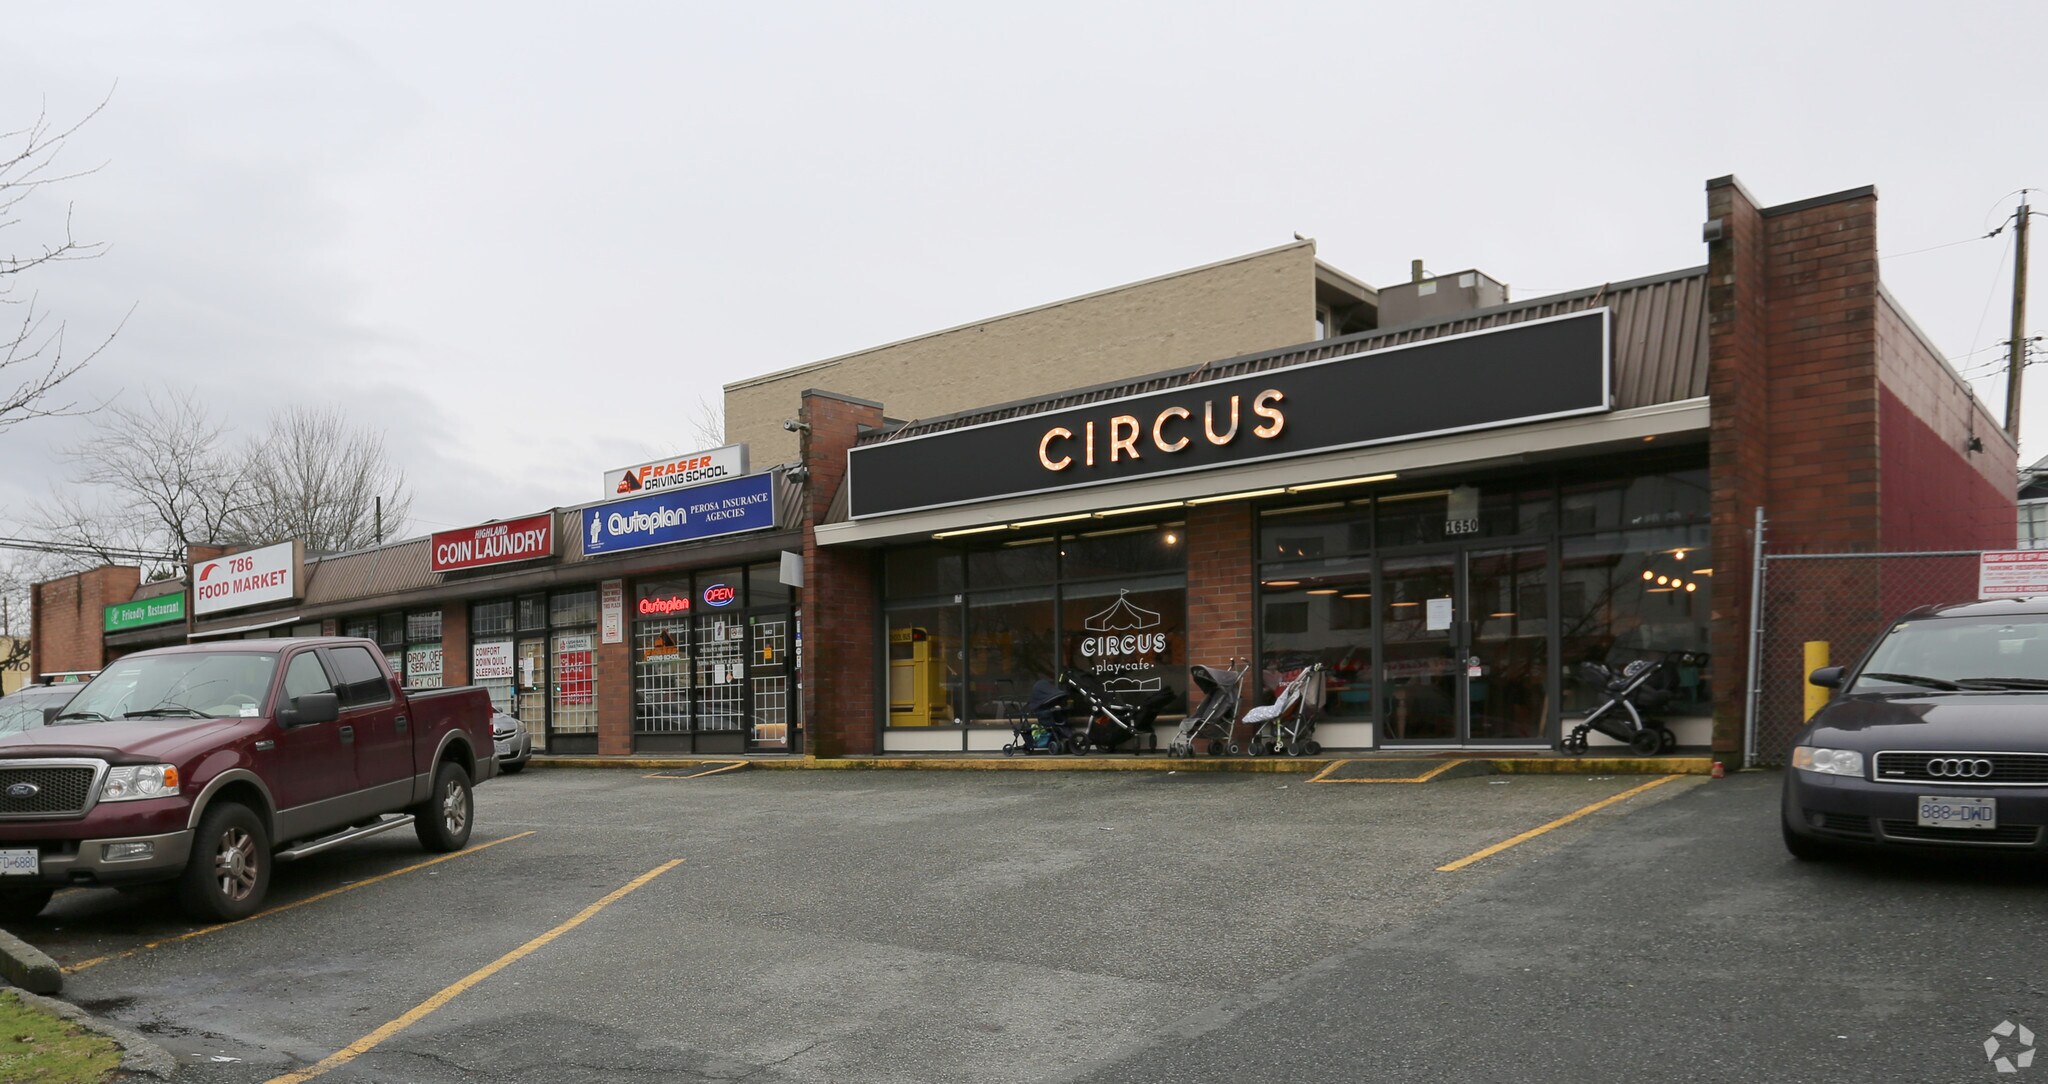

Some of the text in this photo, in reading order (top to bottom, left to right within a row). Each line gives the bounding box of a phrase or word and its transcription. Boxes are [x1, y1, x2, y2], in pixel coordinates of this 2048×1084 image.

[1038, 388, 1285, 471] CIRCUS
[638, 455, 712, 485] FRASER
[645, 465, 728, 491] DRIVING SCHOOL
[690, 493, 768, 515] PEROSA INSURANCE
[607, 506, 687, 536] Autoplan
[705, 508, 745, 522] AGENCIES
[475, 525, 508, 539] HIGHLAND
[1446, 519, 1478, 534] 1650
[437, 528, 547, 565] COIN LAUNDRY
[229, 556, 253, 574] 786
[199, 570, 287, 600] FOOD MARKET
[706, 588, 734, 601] OPEN
[122, 601, 179, 621] Friendly Restaurant
[640, 596, 690, 614] Autoplan
[475, 646, 500, 656] COMFORT
[1081, 633, 1166, 657] CIRCUS
[407, 650, 443, 663] DROP OFF
[475, 656, 507, 667] DOWN QUILT
[411, 661, 440, 673] SERVICE
[475, 666, 512, 677] SLEEPING BAG
[427, 677, 441, 688] CUT
